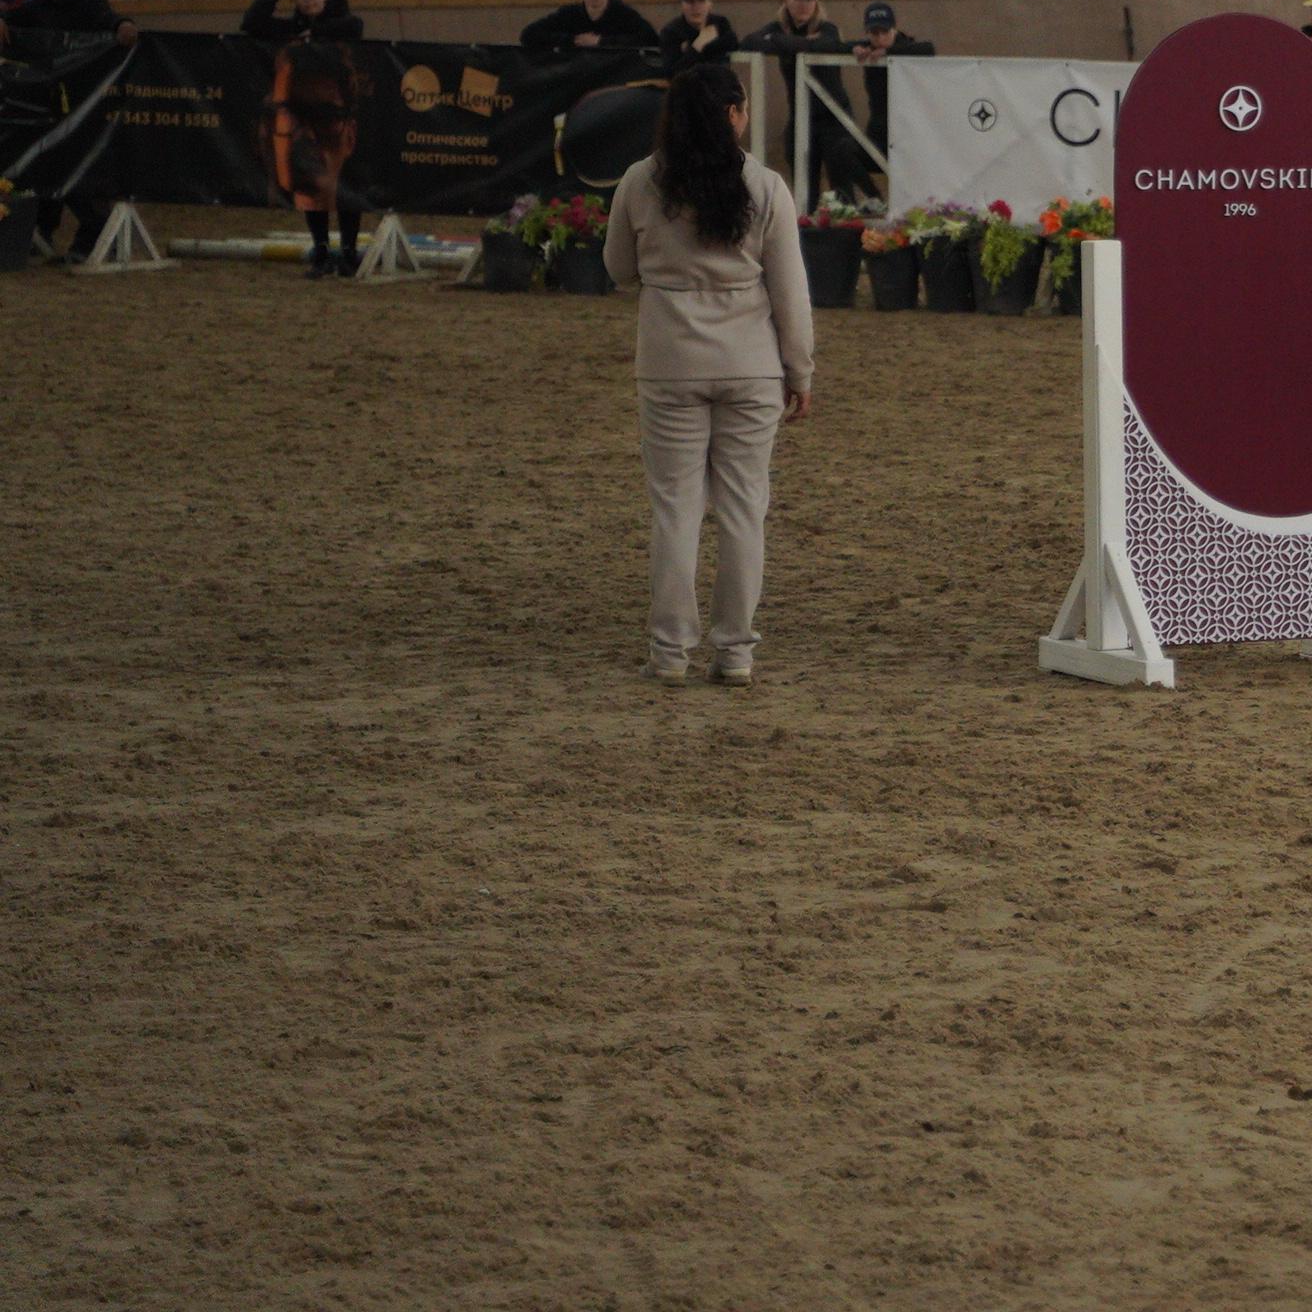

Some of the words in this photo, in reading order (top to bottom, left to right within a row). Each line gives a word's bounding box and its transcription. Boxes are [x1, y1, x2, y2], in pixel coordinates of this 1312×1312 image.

[405, 130, 489, 148] Оптическое
[400, 150, 498, 167] пространство
[1223, 202, 1257, 218] 1996
